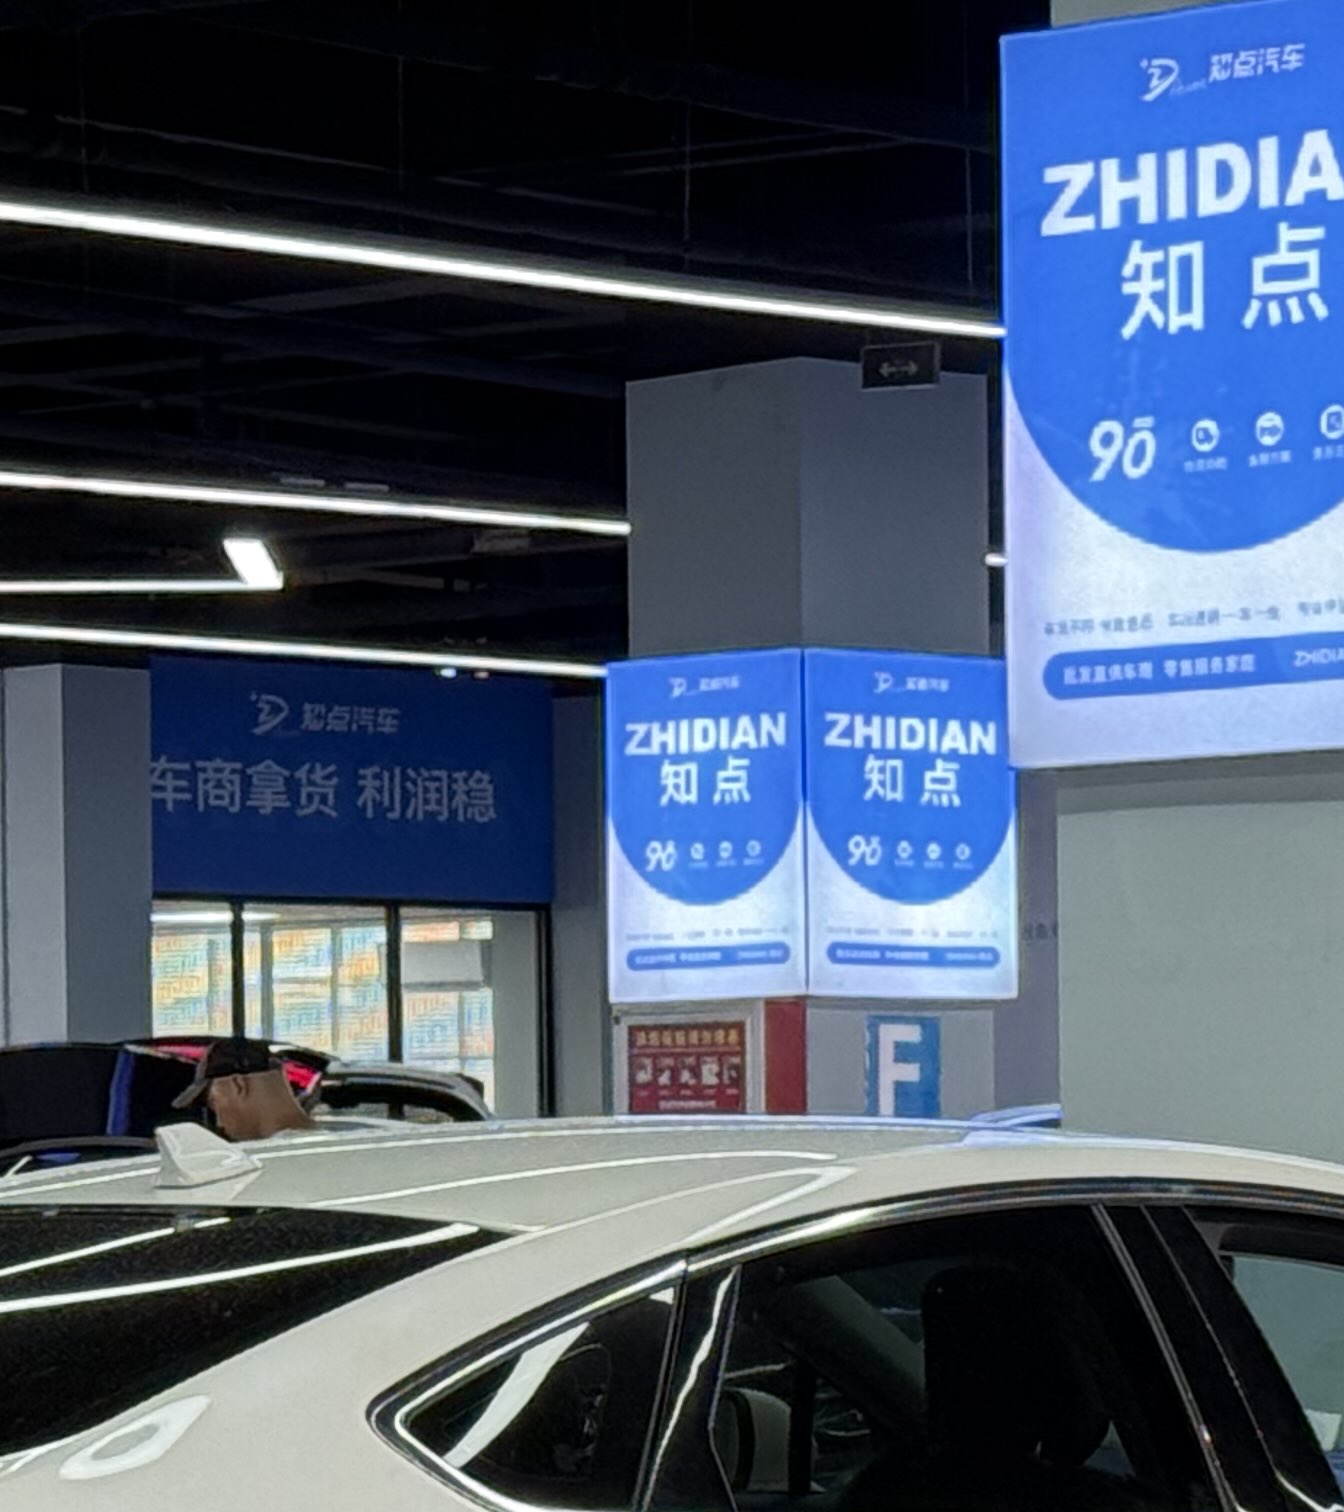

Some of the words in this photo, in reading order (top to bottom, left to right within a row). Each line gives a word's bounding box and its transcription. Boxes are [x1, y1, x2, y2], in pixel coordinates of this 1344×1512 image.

[1120, 223, 1329, 339] 知点
[624, 712, 786, 756] ZHIDIAN
[824, 712, 997, 755] ZHIDIAN
[150, 755, 340, 818] 车商拿货
[357, 765, 497, 824] 利润稳
[660, 756, 751, 806] 知点
[864, 755, 960, 807] 知点
[878, 1023, 922, 1117] F
